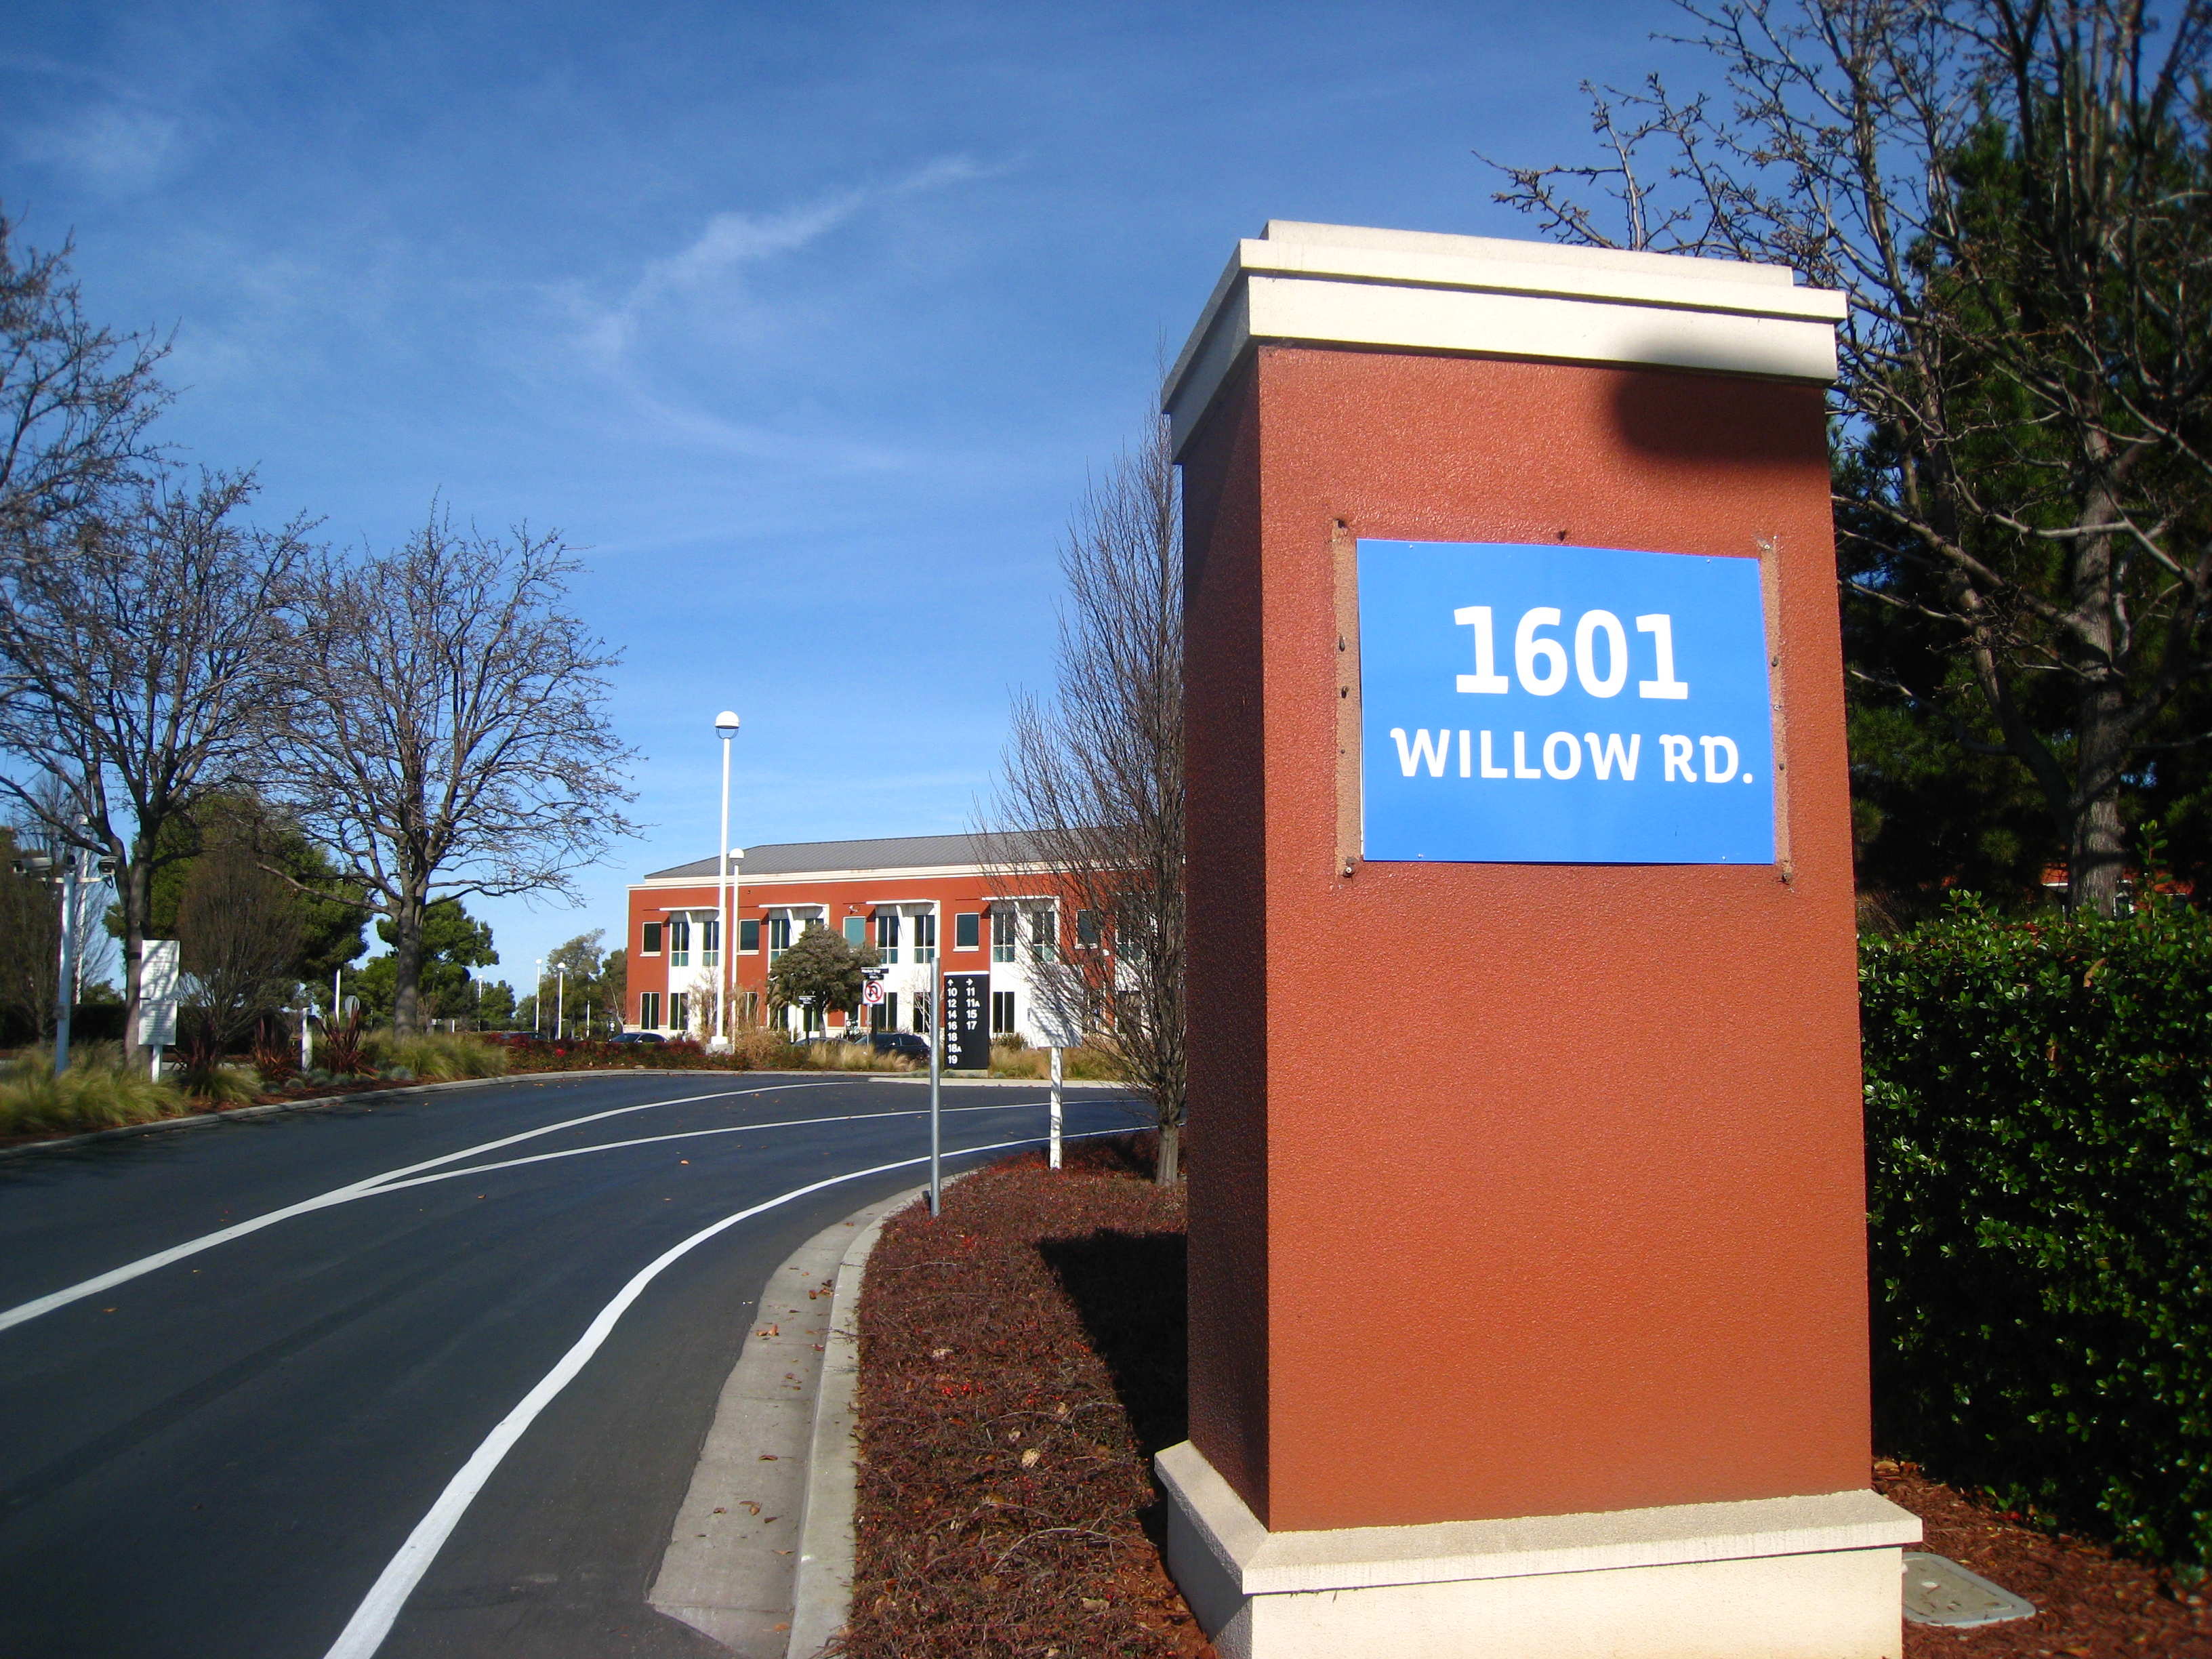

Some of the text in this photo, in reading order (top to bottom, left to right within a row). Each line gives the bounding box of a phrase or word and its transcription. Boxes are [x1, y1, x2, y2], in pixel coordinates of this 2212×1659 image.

[1454, 606, 1687, 699] 1601
[1391, 728, 1753, 783] WILLOW RD.
[947, 987, 957, 996] 10
[966, 987, 975, 996] 11
[947, 998, 956, 1008] 12
[947, 1010, 957, 1019] 14
[966, 1010, 977, 1019] 15
[947, 1021, 958, 1030] 16
[966, 1021, 977, 1030] 17
[947, 1032, 958, 1042] 18
[947, 1054, 958, 1064] 19
